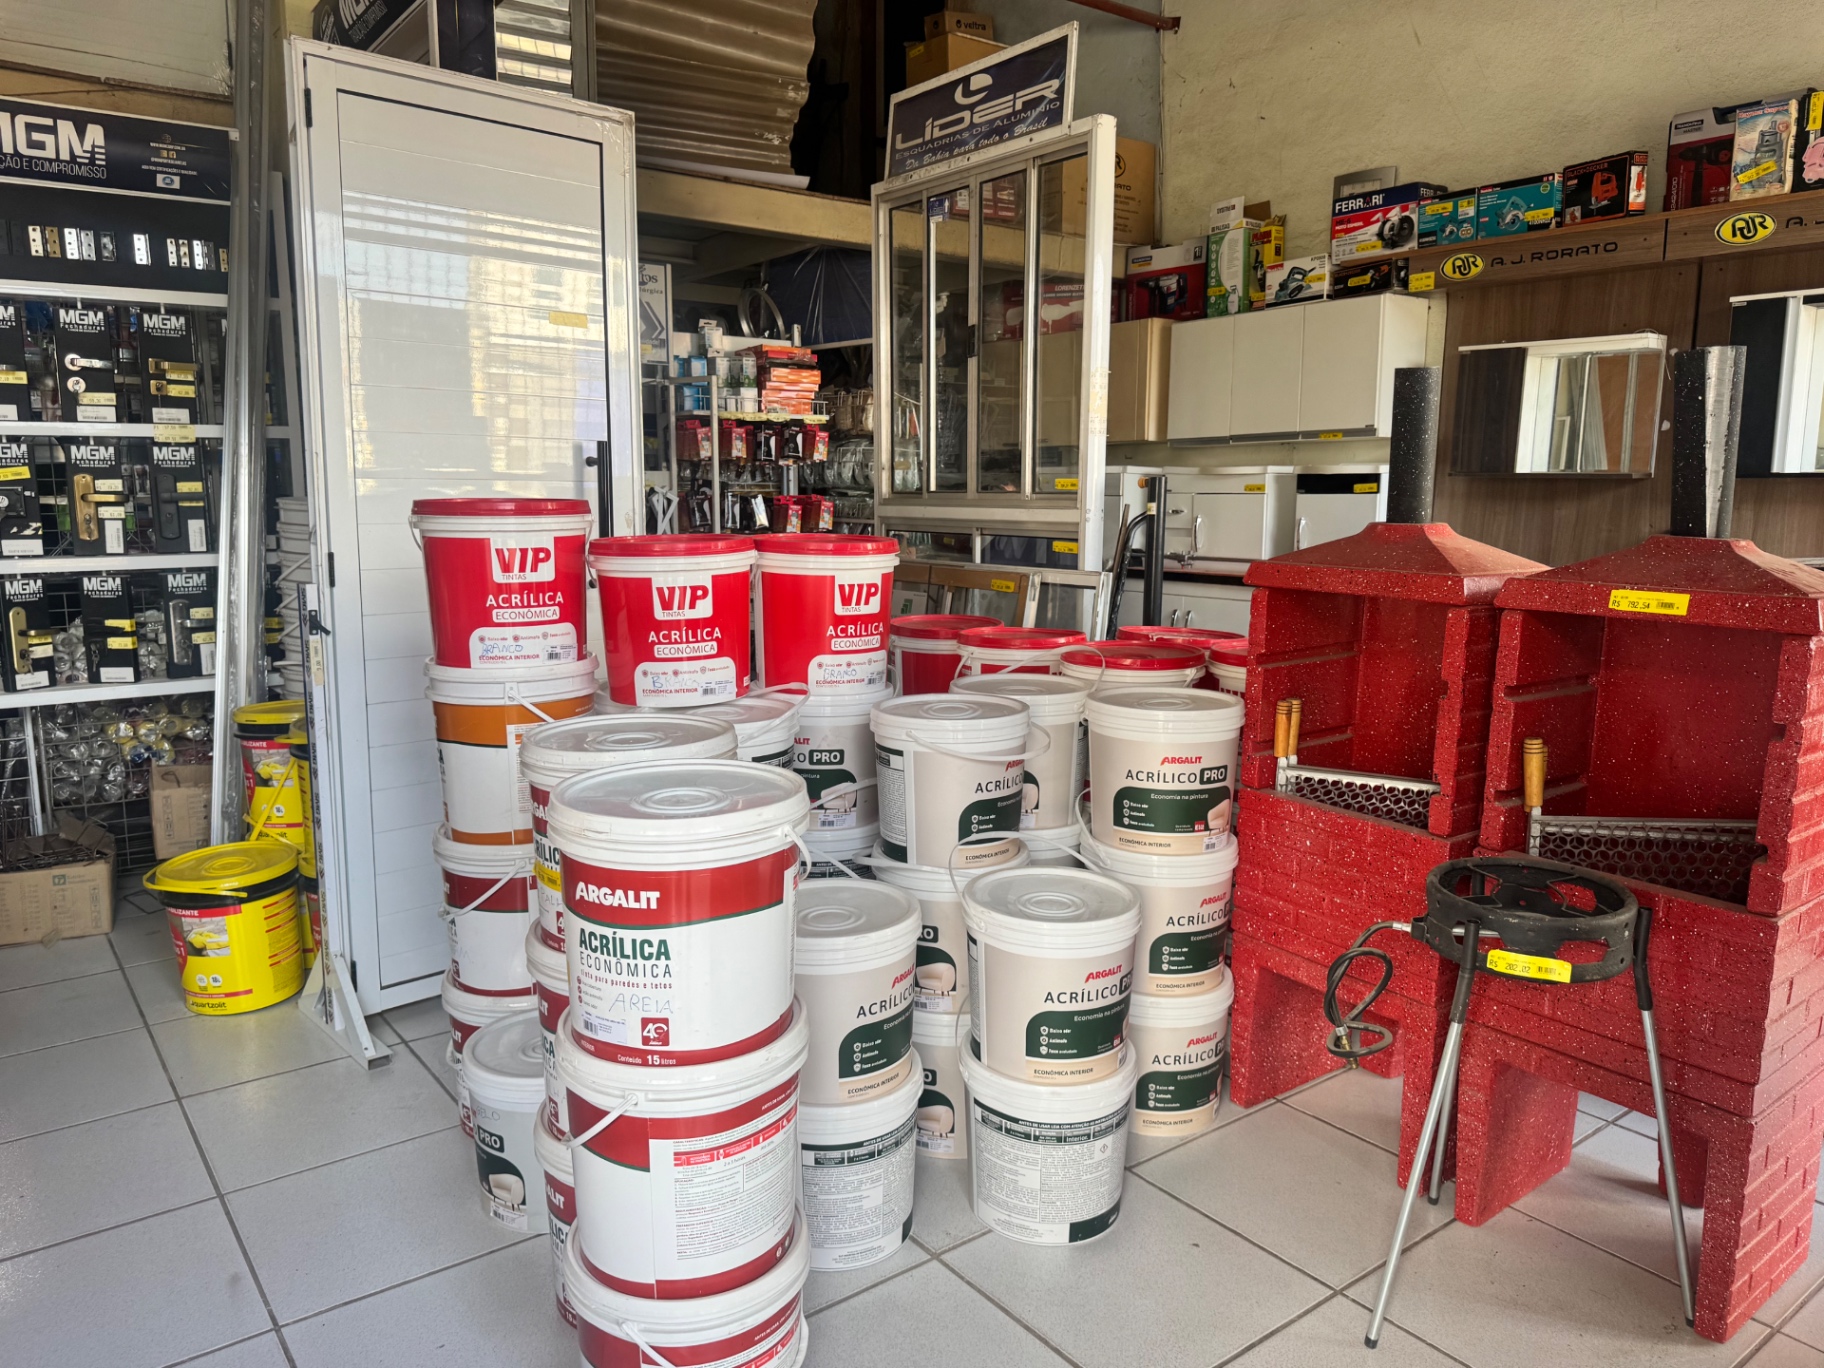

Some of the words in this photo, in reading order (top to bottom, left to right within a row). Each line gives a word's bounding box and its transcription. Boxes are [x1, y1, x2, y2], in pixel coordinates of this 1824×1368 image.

[963, 21, 987, 31] veltra
[895, 131, 969, 160] ESQUADRIAS
[972, 124, 990, 135] DE
[923, 150, 950, 165] Bahia
[978, 135, 1000, 149] todo
[1013, 117, 1049, 137] Brasil
[23, 158, 31, 170] E
[32, 160, 107, 180] COMPROMISSO
[1335, 194, 1383, 213] FERRARI
[1531, 241, 1619, 262] RORATO
[640, 286, 663, 295] lúrgica
[59, 309, 104, 325] MGM
[143, 314, 186, 330] MGM
[0, 443, 28, 458] GM
[70, 445, 115, 460] MGM
[153, 446, 195, 460] MGM
[494, 547, 552, 574] VIP
[5, 579, 43, 595] MGM
[83, 577, 122, 591] MGM
[168, 573, 207, 587] MGM
[486, 591, 564, 607] ACRÍLICA
[656, 585, 709, 611] VIP
[838, 582, 880, 607] VIP
[495, 608, 558, 620] ECONÔMICA
[648, 626, 722, 643] ACRÍLICA
[826, 621, 884, 638] ACRÍLICA
[481, 643, 524, 657] BRANCO
[656, 642, 716, 656] ECONÔMICA
[832, 636, 881, 650] ECONÔMICA
[479, 653, 513, 661] ECONÔMICA
[642, 687, 673, 695] ECONÔMICA
[794, 737, 811, 746] ALIT
[813, 752, 840, 762] PRO
[1160, 756, 1203, 766] ARGALIT
[1125, 769, 1198, 784] ACRÍLICO
[1203, 768, 1226, 782] PRO
[1189, 793, 1209, 801] pintura
[1119, 837, 1147, 847] ECONÔMICA
[535, 838, 560, 865] RÍLIC
[965, 851, 993, 861] ECONÔMICA
[575, 881, 660, 910] ARGALIT
[1200, 892, 1227, 908] ARGALIT
[1166, 909, 1224, 927] ACRÍLICO
[579, 928, 671, 961] ACRÍLICA
[1190, 933, 1213, 941] Economia
[580, 951, 672, 978] ECONÔMICA
[595, 975, 608, 984] para
[611, 978, 639, 988] paredes
[1084, 964, 1123, 984] ARGALIT
[1044, 983, 1118, 1004] ACRÍLICO
[1122, 977, 1133, 991] PR
[608, 993, 674, 1014] AREIA
[1074, 1011, 1103, 1022] Economia
[1104, 1009, 1110, 1017] na
[1186, 1031, 1217, 1048] ARGALIT
[617, 1054, 642, 1064] Conteúdo
[646, 1054, 660, 1065] 15
[661, 1057, 676, 1065] litros
[1151, 1048, 1214, 1066] ACRÍLICO
[1034, 1068, 1069, 1077] ECONÔMICA
[1177, 1072, 1202, 1080] Economia
[847, 1082, 880, 1095] ECONÔMICA
[881, 1072, 900, 1087] INTERIOR
[480, 1131, 500, 1149] PRO
